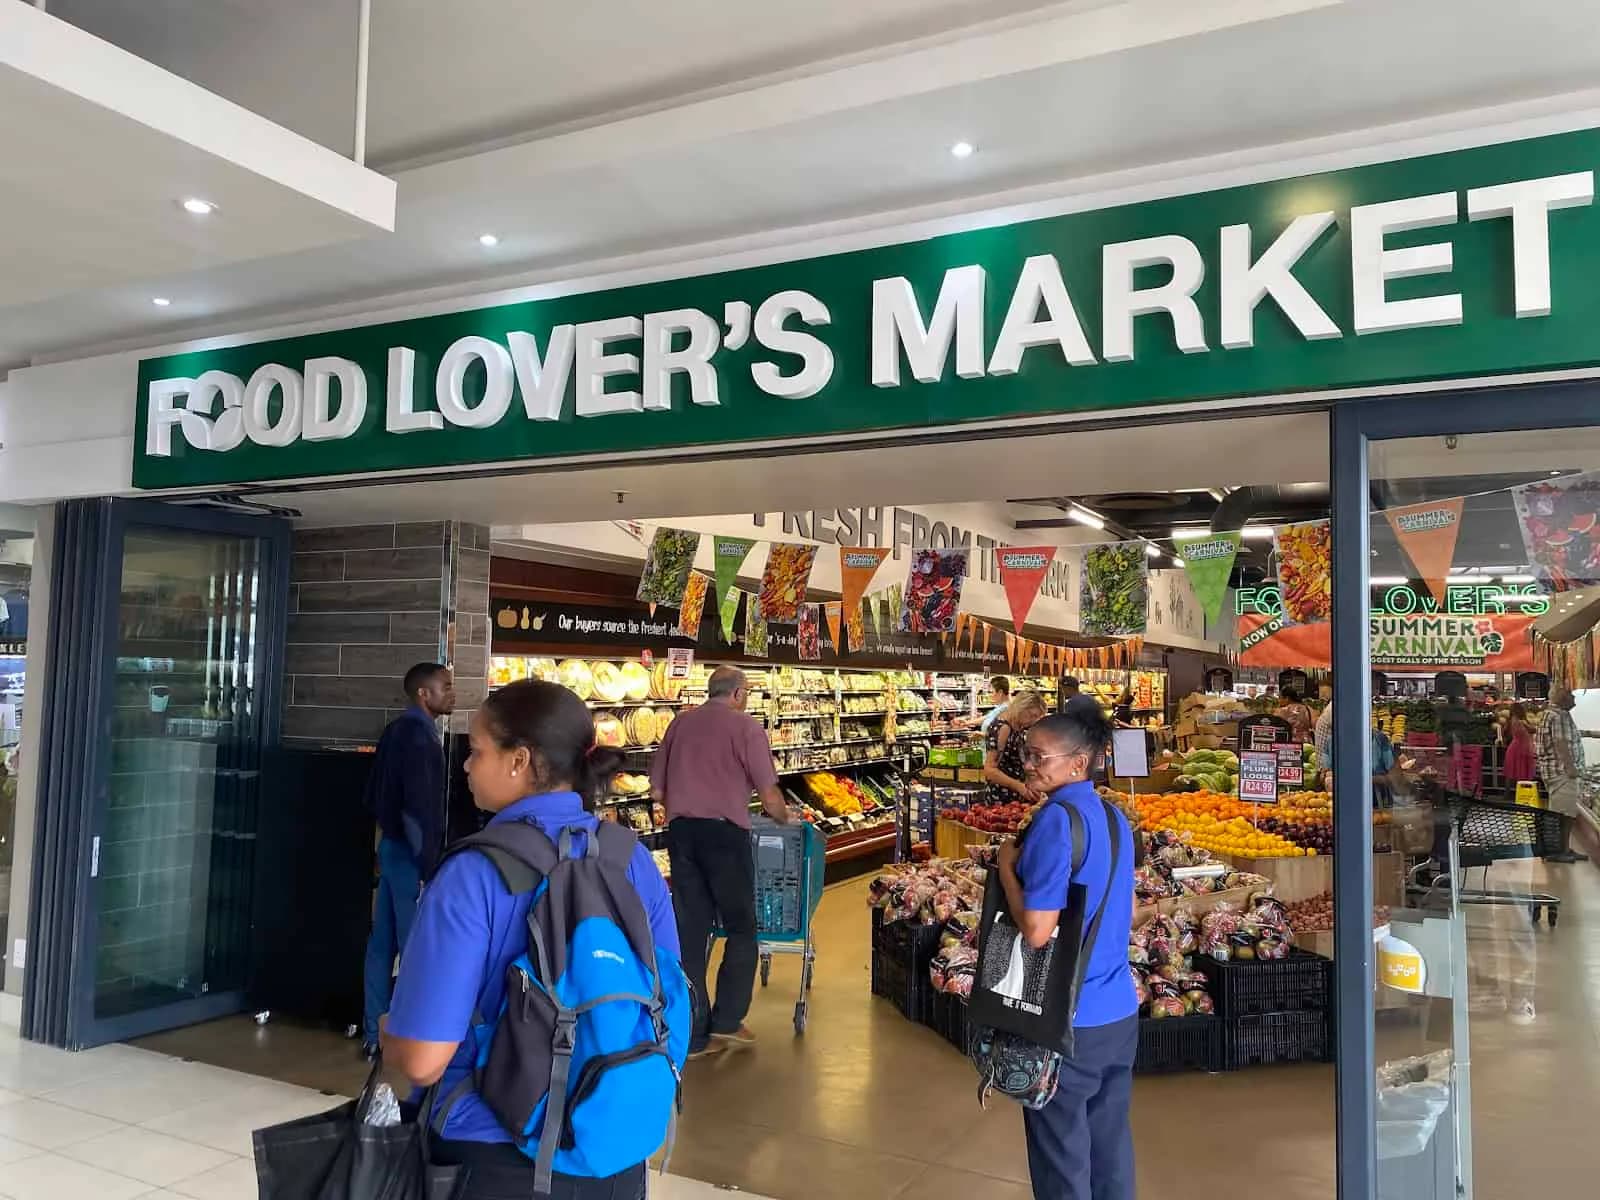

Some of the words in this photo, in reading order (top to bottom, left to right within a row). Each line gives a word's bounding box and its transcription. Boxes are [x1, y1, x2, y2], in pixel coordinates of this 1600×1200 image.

[146, 356, 368, 457] FOOD
[386, 289, 835, 434] LOVER'S
[871, 170, 1594, 388] MARKET
[575, 615, 601, 634] buyers
[602, 621, 626, 634] source
[628, 619, 639, 634] the
[1370, 618, 1475, 636] SUMMER
[1242, 626, 1269, 648] NOW
[1370, 655, 1395, 665] GGEST
[1396, 656, 1421, 665] DEALS
[1422, 656, 1433, 665] OF
[1434, 656, 1449, 665] THE
[1450, 656, 1483, 666] SEASON
[1243, 765, 1274, 773] PLUMS
[1245, 781, 1273, 793] R24.99
